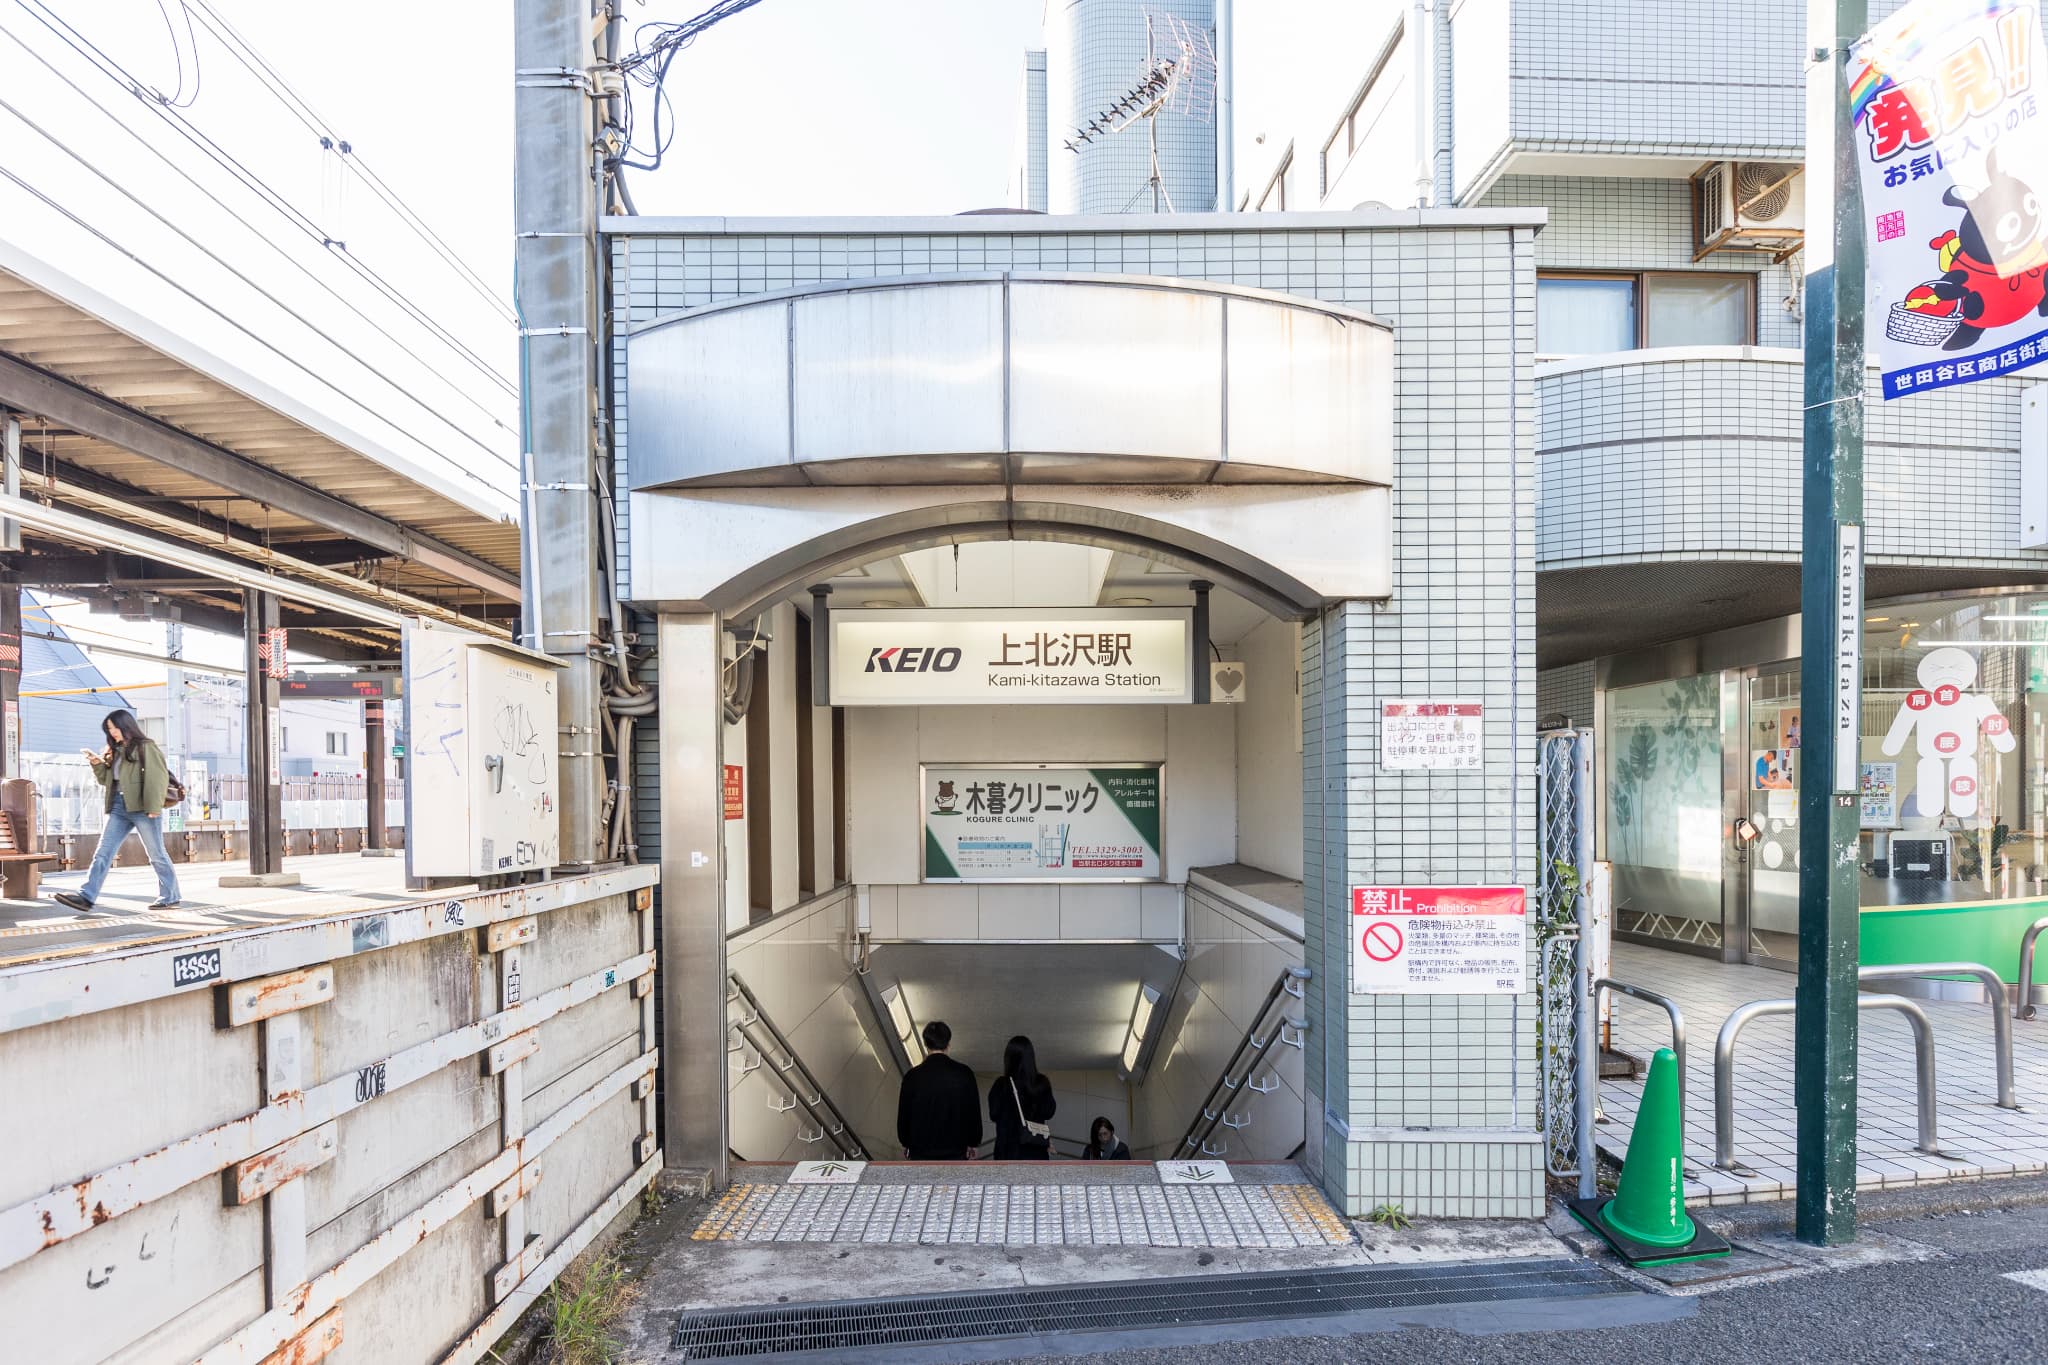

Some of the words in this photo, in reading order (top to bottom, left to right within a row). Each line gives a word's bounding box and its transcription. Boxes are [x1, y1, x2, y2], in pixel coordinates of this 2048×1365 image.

[1883, 94, 2037, 188] お気に入りの店
[865, 647, 962, 673] KEIO
[988, 633, 1133, 668] 上北沢駅
[988, 672, 1099, 687] Kami-kitazawa
[1105, 672, 1161, 687] Station
[966, 781, 1100, 815] 木暮クリニック
[1113, 789, 1155, 798] アレルギー科
[1838, 796, 1852, 807] 14
[1362, 889, 1413, 914] 禁止
[1416, 903, 1477, 913] Prohibition
[1408, 919, 1497, 931] 危険物持込み禁止
